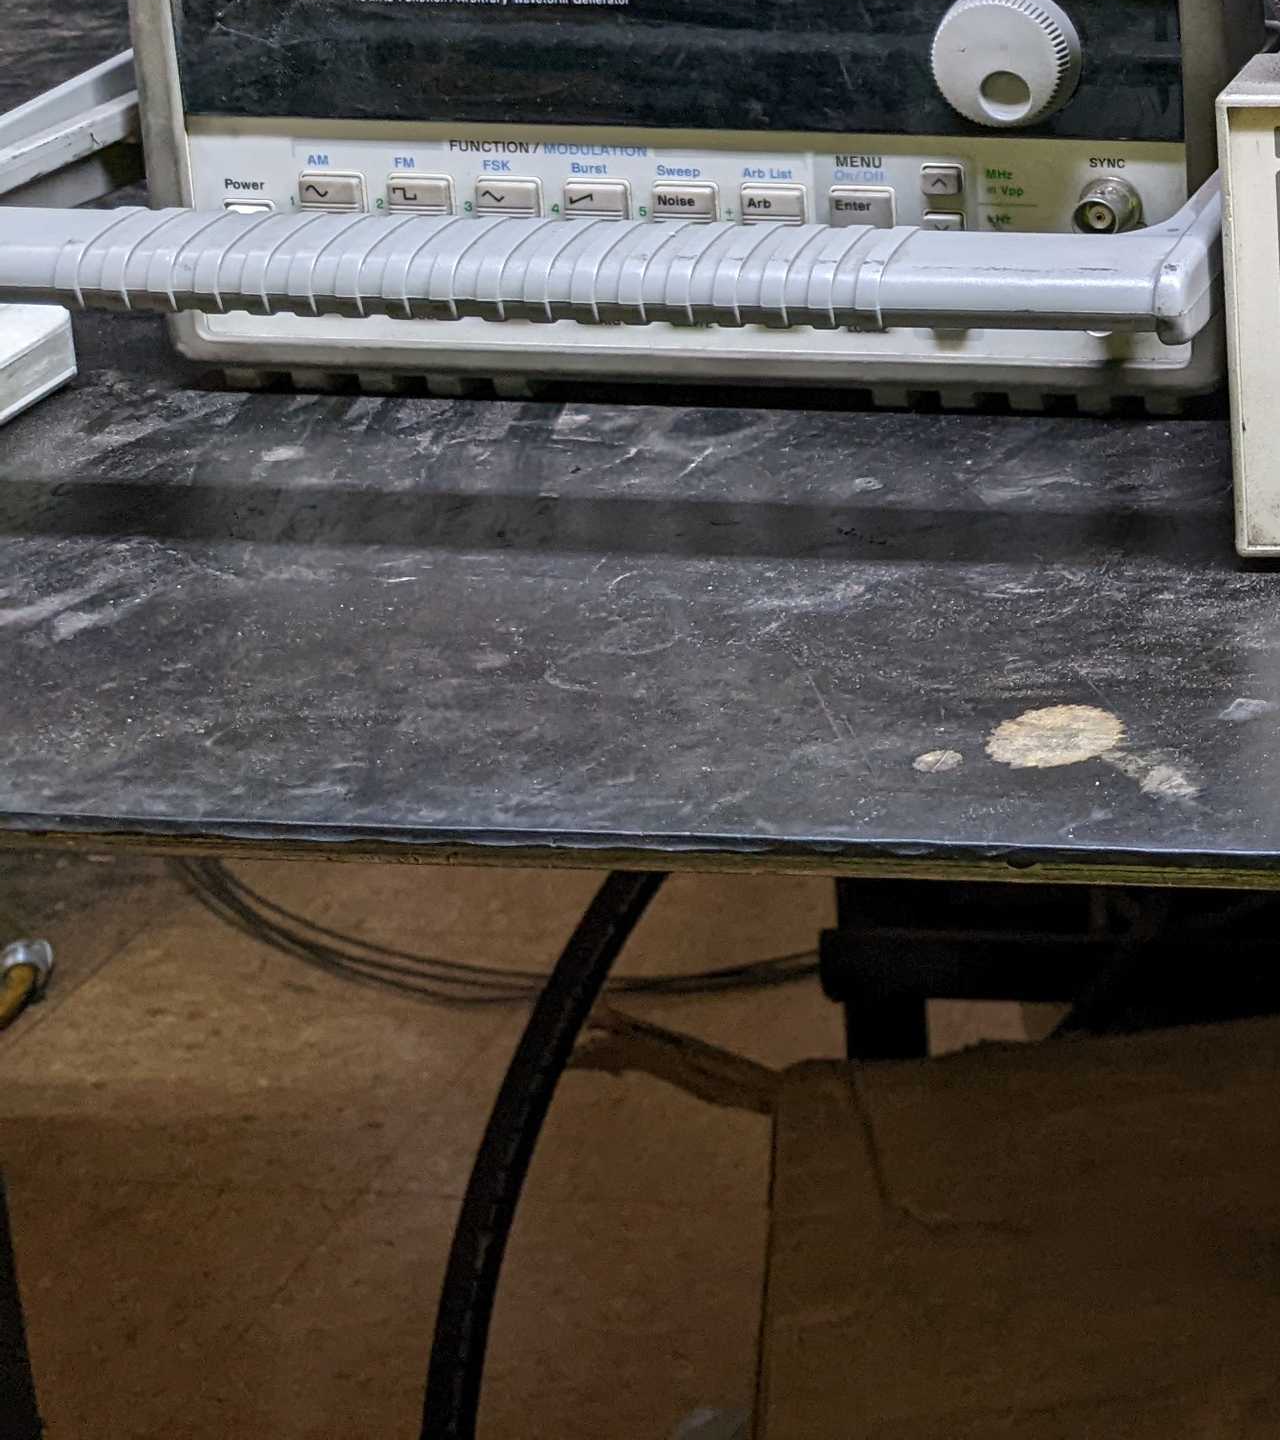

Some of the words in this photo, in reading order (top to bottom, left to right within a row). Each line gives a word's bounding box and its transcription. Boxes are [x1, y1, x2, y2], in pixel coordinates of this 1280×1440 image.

[543, 142, 648, 157] MODULATION
[307, 154, 329, 166] AM
[394, 157, 415, 169] FM
[482, 159, 511, 172] FSK
[571, 162, 608, 175] Burst
[656, 164, 701, 180] Sweep
[835, 155, 883, 169] MENU
[1089, 157, 1126, 169] SYNC
[742, 167, 764, 179] Arb
[767, 167, 792, 180] List
[833, 169, 885, 183] On/Off
[985, 168, 1013, 181] MHz
[224, 178, 264, 193] Power
[657, 194, 695, 207] Noise
[747, 197, 771, 210] Arb
[834, 199, 871, 212] Enter
